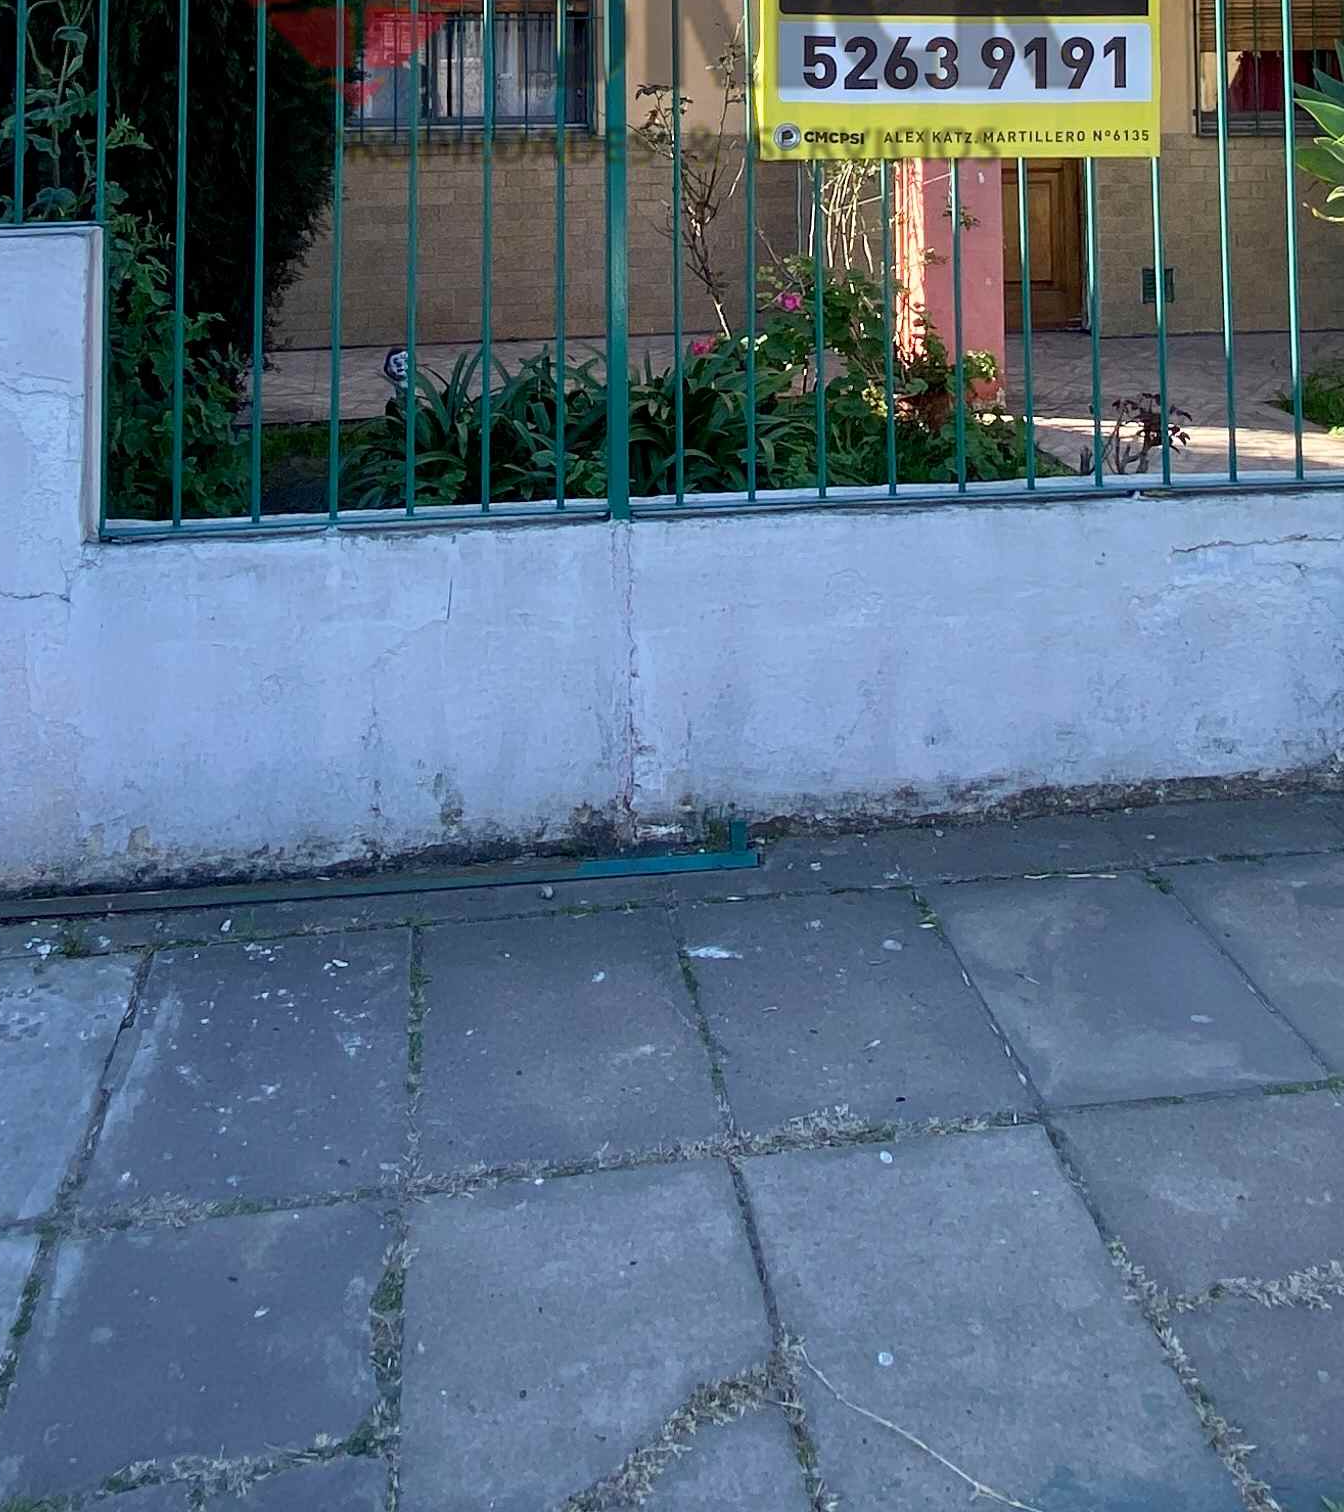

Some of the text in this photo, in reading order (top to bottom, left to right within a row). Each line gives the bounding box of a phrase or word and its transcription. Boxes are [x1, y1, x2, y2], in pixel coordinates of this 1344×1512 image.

[803, 36, 1127, 90] 5263 9191
[804, 131, 865, 145] CMCPSI
[883, 131, 925, 144] ALEX
[983, 131, 1086, 143] MARTILLERO
